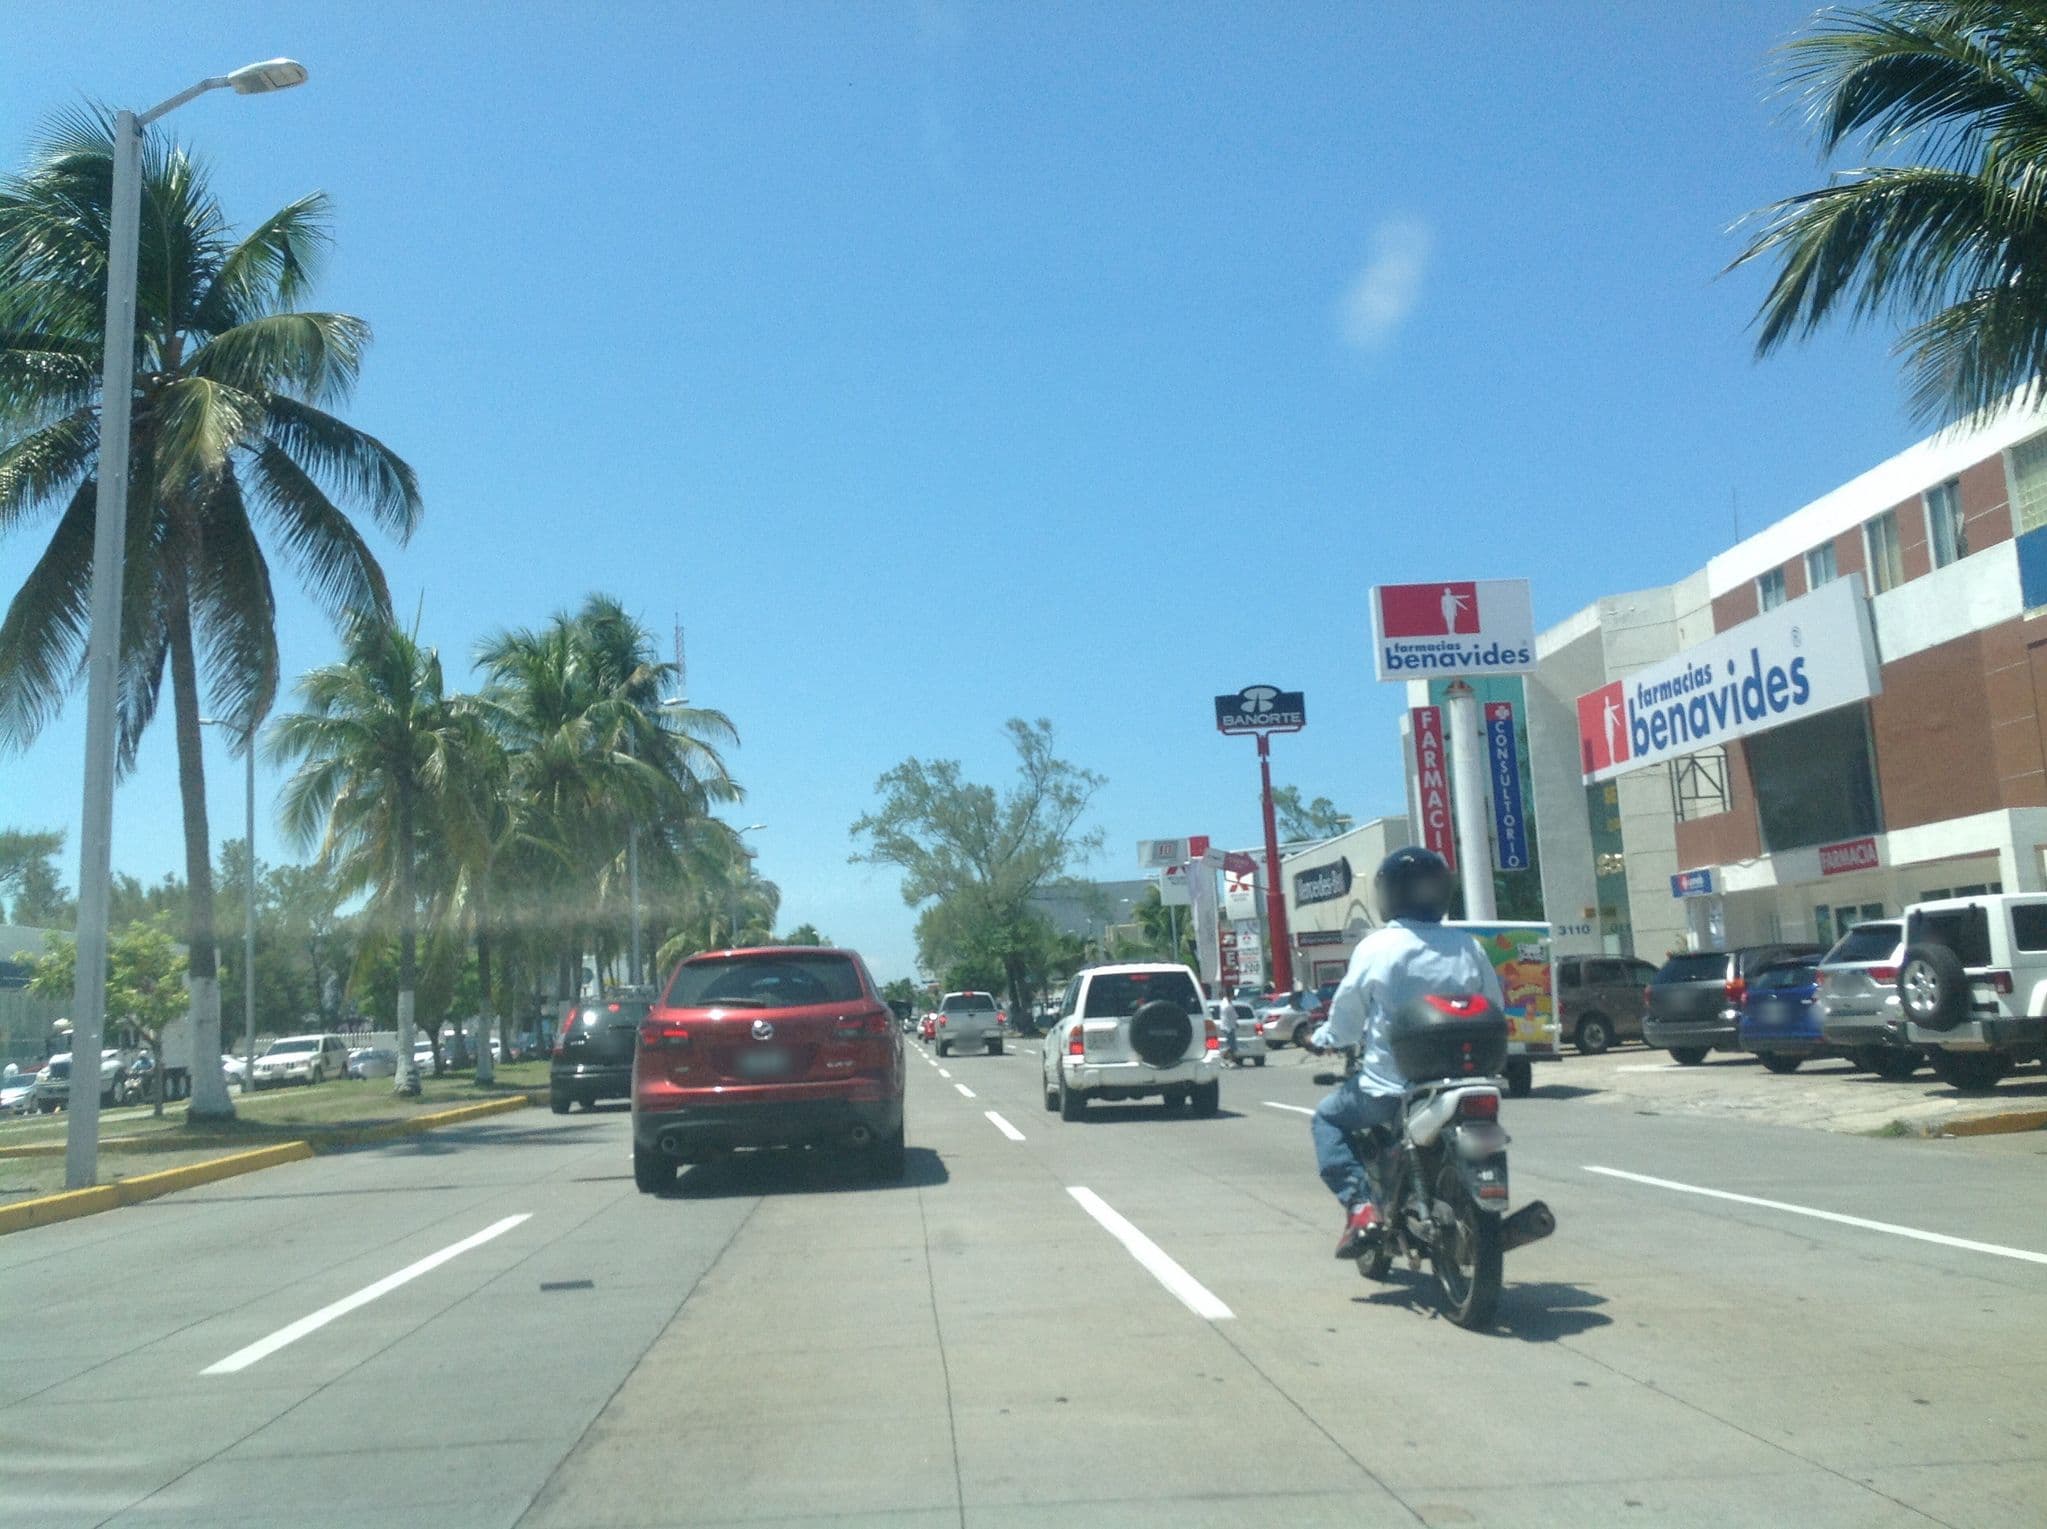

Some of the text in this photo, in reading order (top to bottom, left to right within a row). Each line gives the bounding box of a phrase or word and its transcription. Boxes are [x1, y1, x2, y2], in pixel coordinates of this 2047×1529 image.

[1385, 642, 1530, 670] benavides
[1394, 640, 1461, 653] farmacias
[1637, 662, 1712, 711] farmacias
[1628, 647, 1810, 758] benavides
[1222, 712, 1302, 727] BANORTE
[1494, 720, 1520, 868] CONSULTORIO
[1557, 923, 1592, 936] 3110
